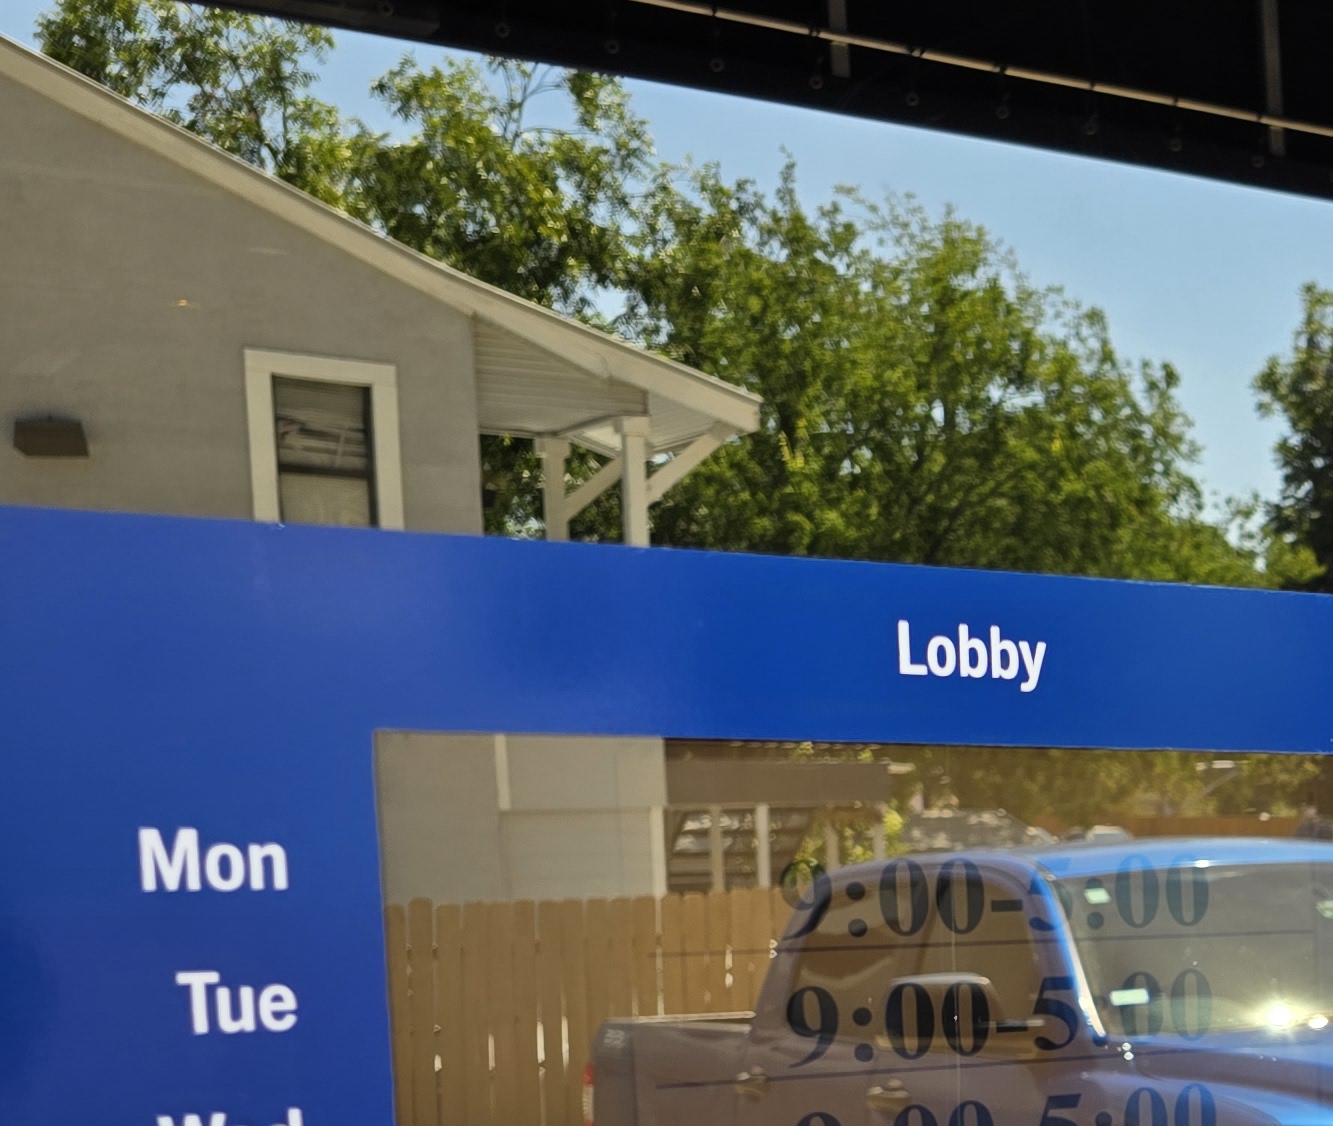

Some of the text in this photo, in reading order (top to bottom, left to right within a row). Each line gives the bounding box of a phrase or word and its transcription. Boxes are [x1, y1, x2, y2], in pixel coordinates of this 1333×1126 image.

[897, 619, 1047, 693] Lobby
[138, 827, 289, 892] Mon
[780, 853, 1211, 940] 9:00-5:00
[175, 971, 298, 1035] Tue
[786, 968, 1213, 1068] 9:00-5:00
